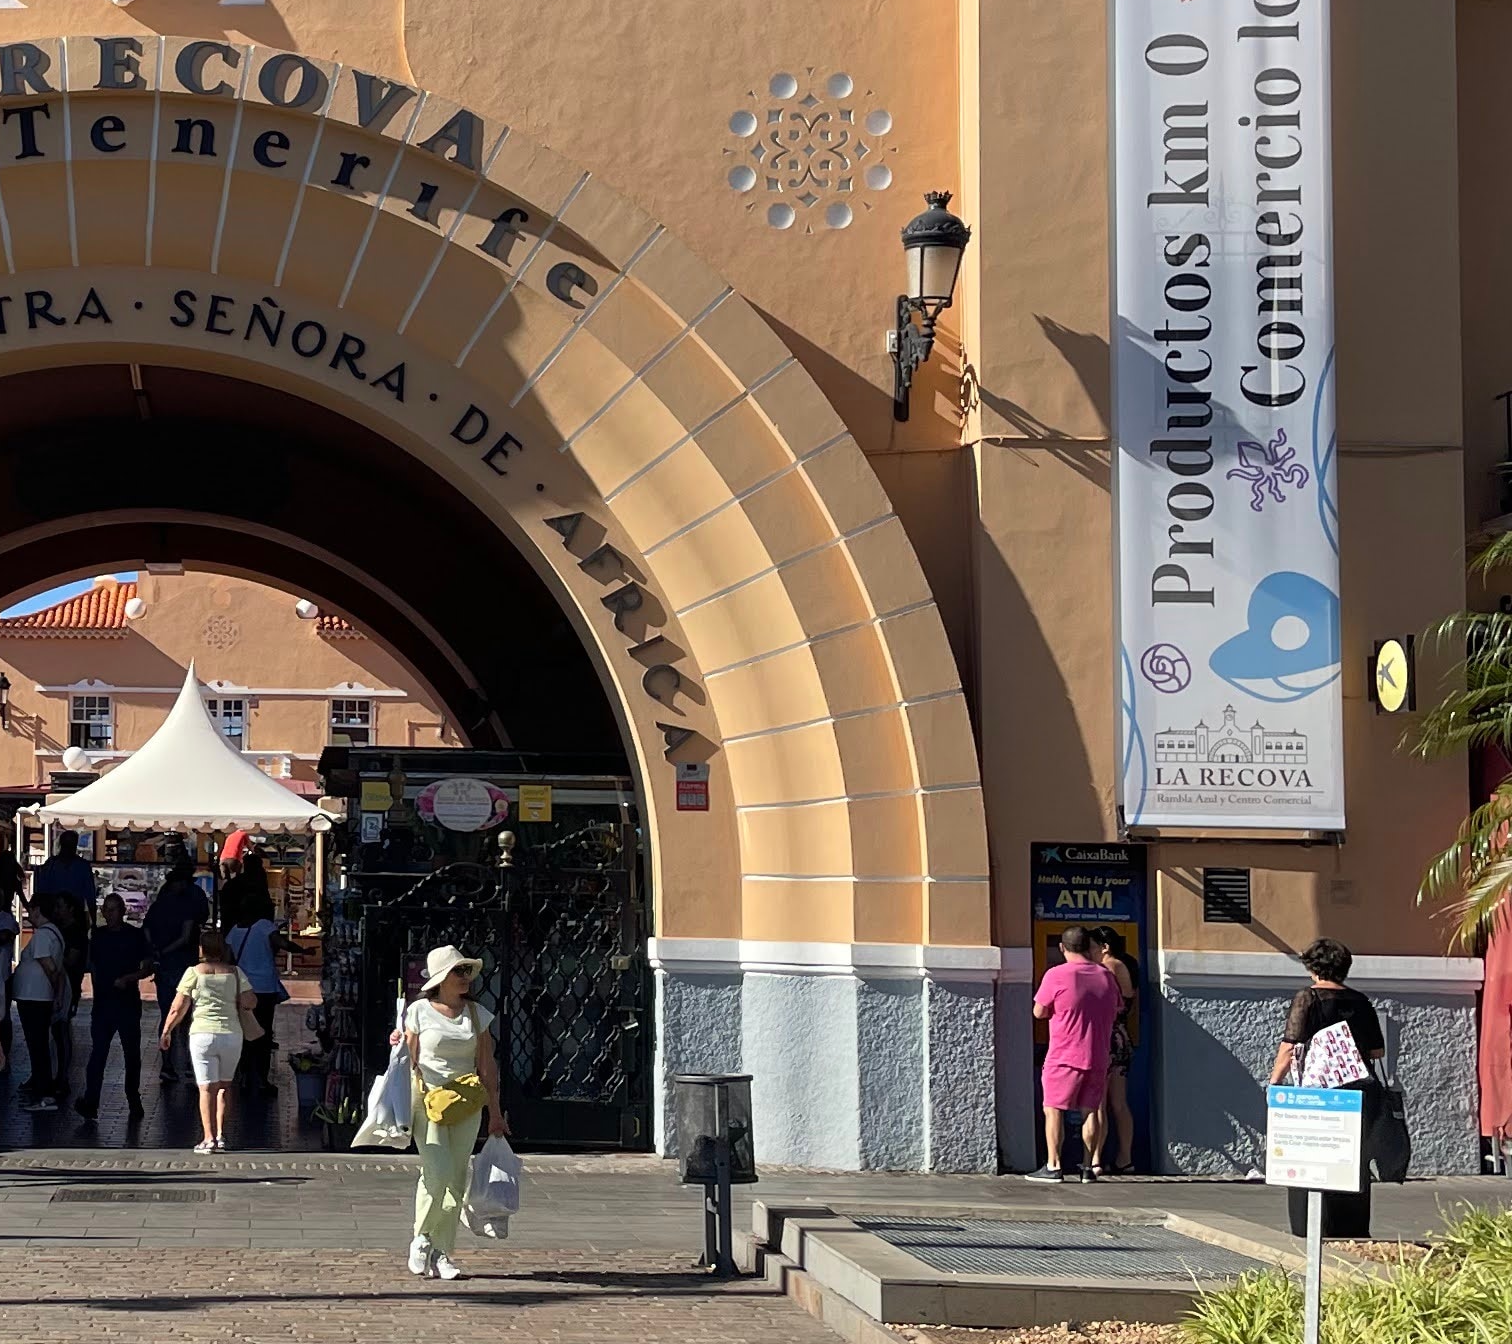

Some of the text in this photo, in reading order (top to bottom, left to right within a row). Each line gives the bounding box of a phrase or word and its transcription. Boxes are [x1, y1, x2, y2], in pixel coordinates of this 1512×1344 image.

[3, 103, 599, 309] Tenerife
[1238, 68, 1305, 407] Comercio
[1145, 33, 1215, 607] Productos km 0
[170, 289, 405, 403] SEÑORA
[450, 404, 523, 476] DE
[543, 511, 706, 762] AFRICA
[1156, 767, 1313, 787] LA RECOVA
[1157, 793, 1192, 804] Rambla
[1195, 794, 1217, 804] Azul
[1228, 794, 1261, 805] Centro
[1264, 795, 1312, 805] Comercial
[1065, 847, 1129, 861] CaixaBank
[1037, 875, 1131, 887] Hello, this is your
[1055, 889, 1113, 909] ATM
